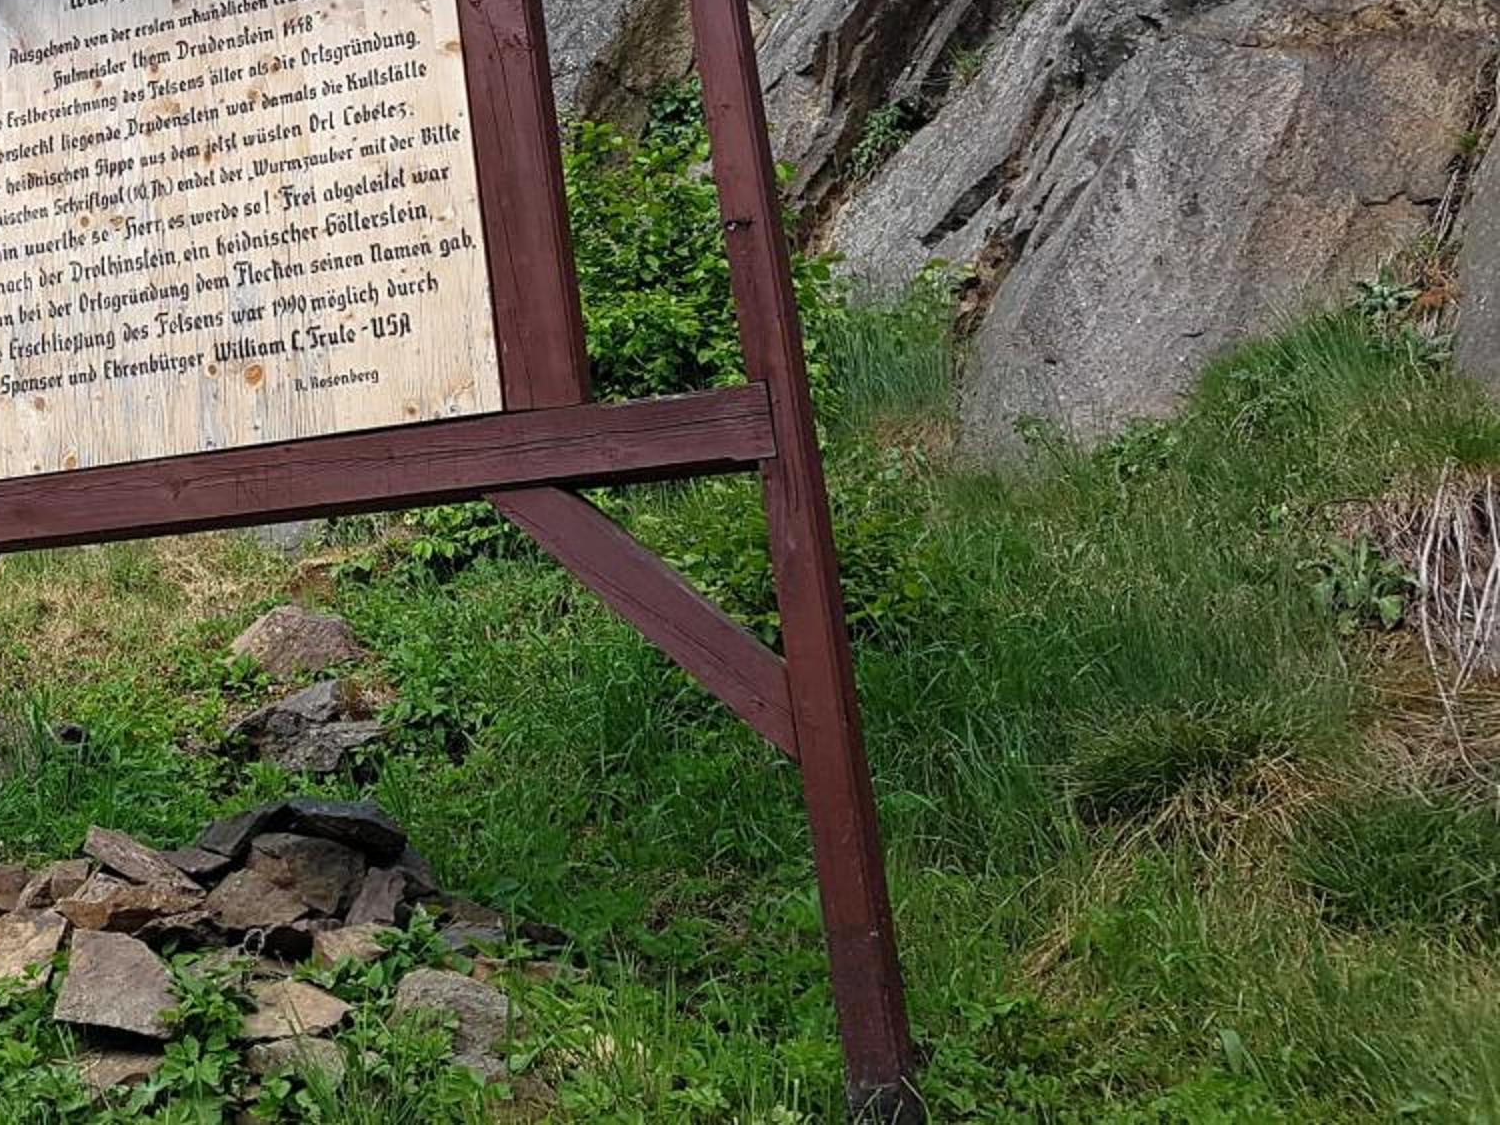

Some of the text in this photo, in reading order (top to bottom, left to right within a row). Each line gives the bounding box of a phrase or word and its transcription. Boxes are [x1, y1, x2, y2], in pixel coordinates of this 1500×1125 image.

[7, 35, 81, 69] Ausgehend
[83, 33, 109, 49] von
[110, 27, 132, 43] der
[134, 17, 175, 38] ersten
[175, 27, 275, 60] Drudenstein
[6, 95, 118, 129] Erstbezeichnung
[122, 88, 145, 104] des
[147, 74, 205, 100] Felsens
[209, 66, 244, 87] älter
[248, 60, 269, 78] als
[270, 54, 296, 74] die
[61, 125, 122, 152] liegende
[225, 98, 256, 117] war
[261, 85, 317, 111] damals
[321, 79, 343, 97] die
[5, 165, 90, 197] heidnischen
[139, 151, 167, 169] aus
[171, 144, 201, 163] dem
[203, 131, 238, 158] jetzt
[242, 123, 303, 148] wüsten
[309, 111, 335, 134] Ort
[53, 185, 125, 218] Schriftgut
[177, 169, 216, 192] endet
[219, 166, 243, 184] der
[359, 137, 387, 158] mit
[389, 134, 415, 152] der
[420, 122, 461, 146] Bitte
[167, 213, 186, 230] es
[189, 202, 239, 227] werde
[279, 185, 317, 213] Frei
[323, 166, 406, 202] abgeleitet
[411, 166, 450, 185] war
[18, 303, 42, 324] bei
[47, 299, 73, 319] der
[78, 281, 190, 315] Ortsgründung
[195, 271, 231, 294] dem
[232, 258, 305, 288] Flecken
[310, 252, 365, 274] seinen
[369, 239, 433, 264] Namen
[439, 226, 477, 253] gab.
[39, 266, 64, 288] der
[183, 241, 211, 262] ein
[215, 223, 319, 257] heidnischer
[122, 322, 149, 342] des
[153, 310, 224, 338] Felsens
[231, 305, 266, 324] war
[271, 293, 307, 318] 1990
[310, 280, 379, 313] möglich
[387, 271, 439, 299] durch
[0, 371, 63, 399] Sponsor
[68, 362, 98, 386] und
[103, 351, 205, 380] Ehrenbürger
[213, 337, 287, 364] William
